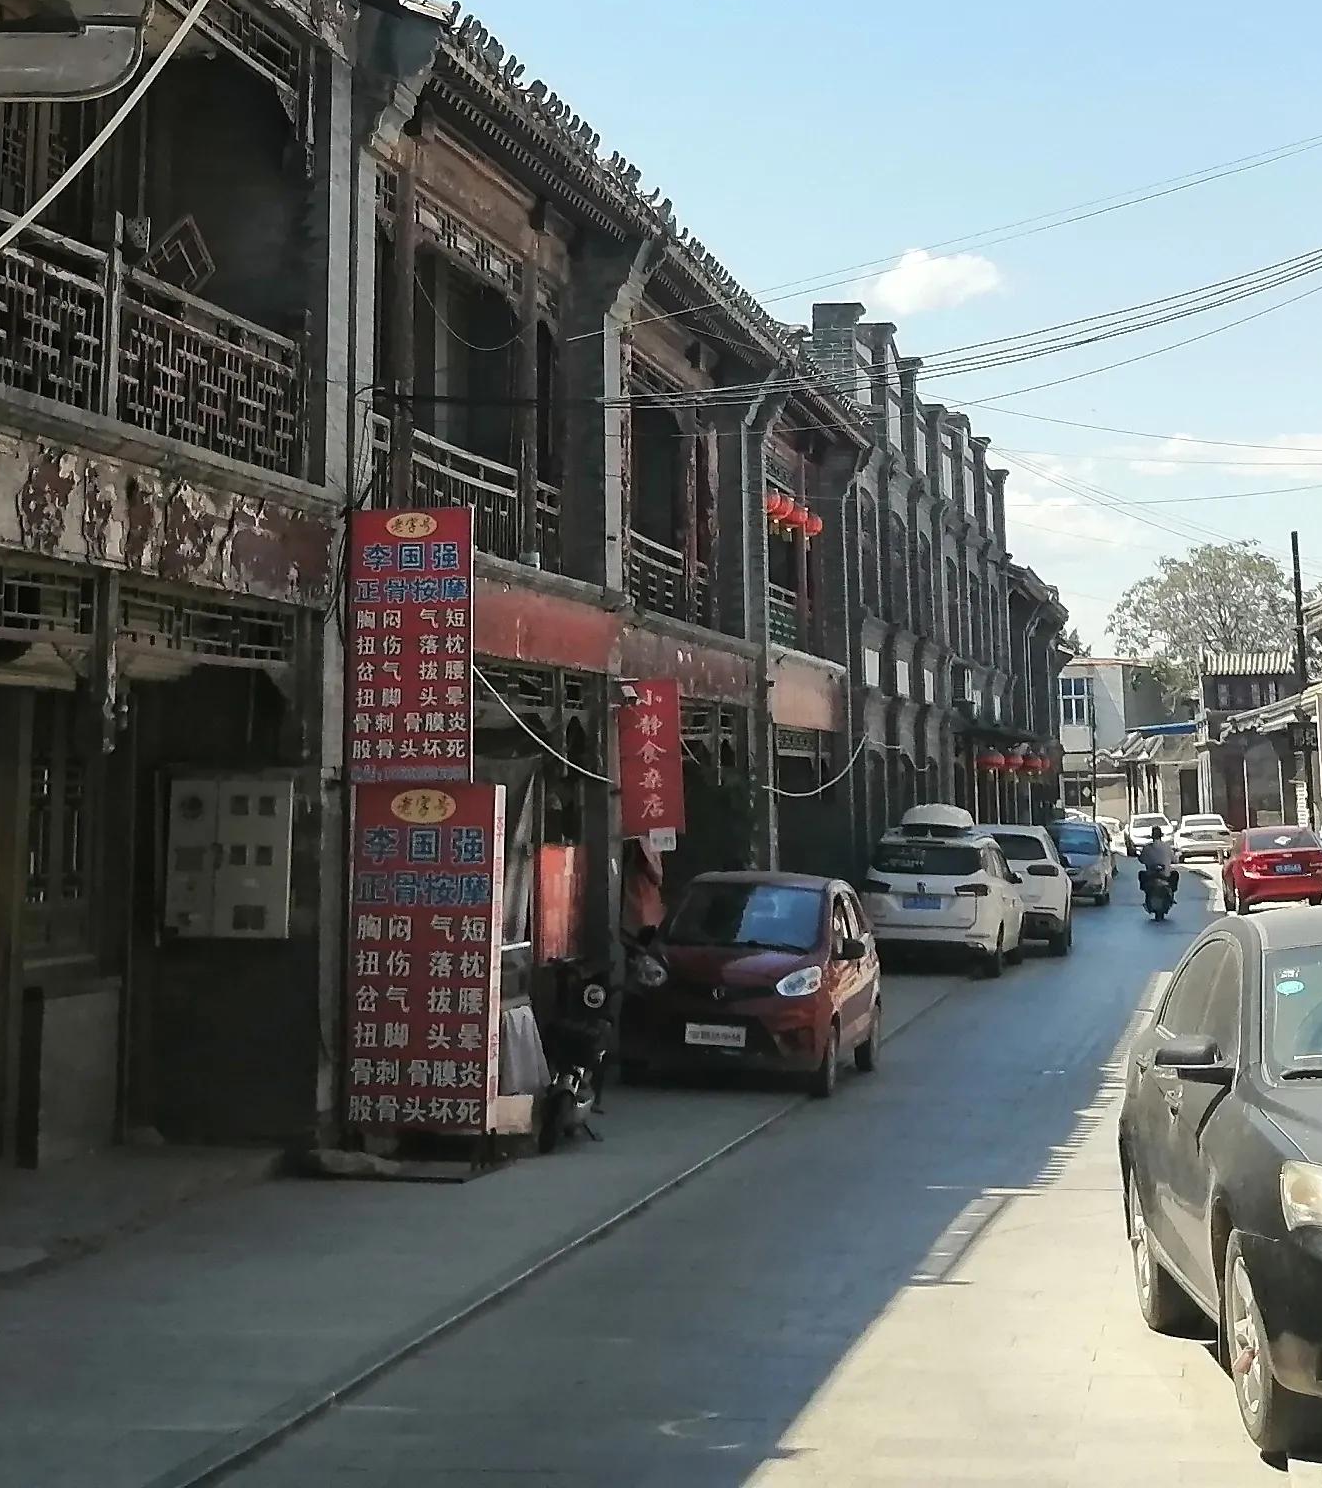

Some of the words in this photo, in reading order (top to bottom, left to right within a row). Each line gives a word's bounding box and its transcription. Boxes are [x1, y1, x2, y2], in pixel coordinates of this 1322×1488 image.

[363, 542, 459, 572] 李国强
[355, 575, 468, 603] 正骨按摩
[357, 609, 401, 629] 胸闷
[420, 608, 466, 628] 气短
[356, 635, 402, 655] 扭伤
[419, 633, 465, 654] 落枕
[357, 660, 402, 681] 岔气
[356, 688, 401, 708] 扭脚
[419, 686, 465, 707] 头晕
[353, 712, 394, 733] 骨刺
[403, 712, 467, 733] 骨膜炎
[352, 738, 466, 759] 股骨头坏死
[363, 825, 485, 864] 李国强
[356, 870, 491, 906] 正骨按摩
[357, 914, 411, 942] 胸闷
[431, 914, 487, 942] 气短
[355, 950, 412, 977] 扭伤
[429, 950, 485, 978] 落枕
[356, 985, 410, 1013] 岔气
[353, 1021, 408, 1048] 扭脚
[427, 1023, 482, 1051] 头晕
[350, 1058, 399, 1086] 骨刺
[407, 1059, 482, 1088] 骨膜炎
[348, 1096, 481, 1125] 股骨头坏死
